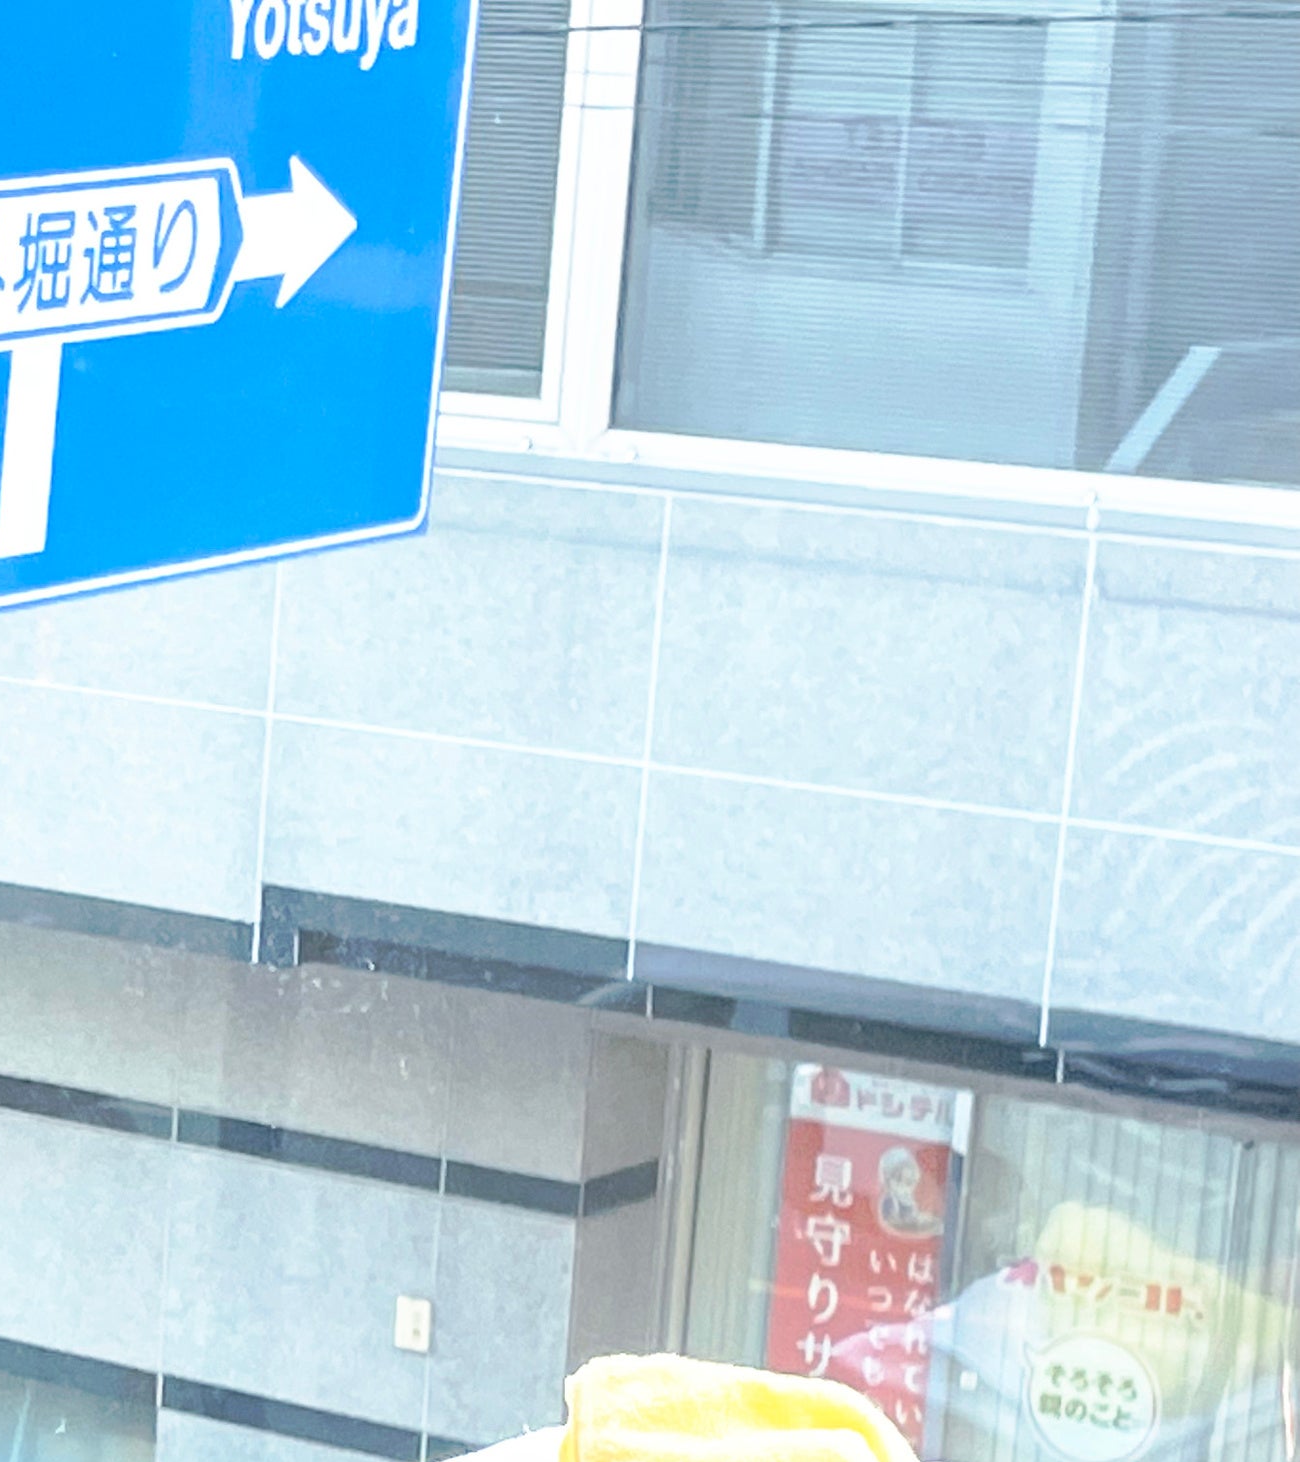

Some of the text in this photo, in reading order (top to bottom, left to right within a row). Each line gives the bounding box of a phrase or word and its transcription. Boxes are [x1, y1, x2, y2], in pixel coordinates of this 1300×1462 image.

[230, 0, 419, 71] Yotsuya
[797, 1155, 854, 1377] 見守りサ
[894, 1251, 935, 1440] はなれてい
